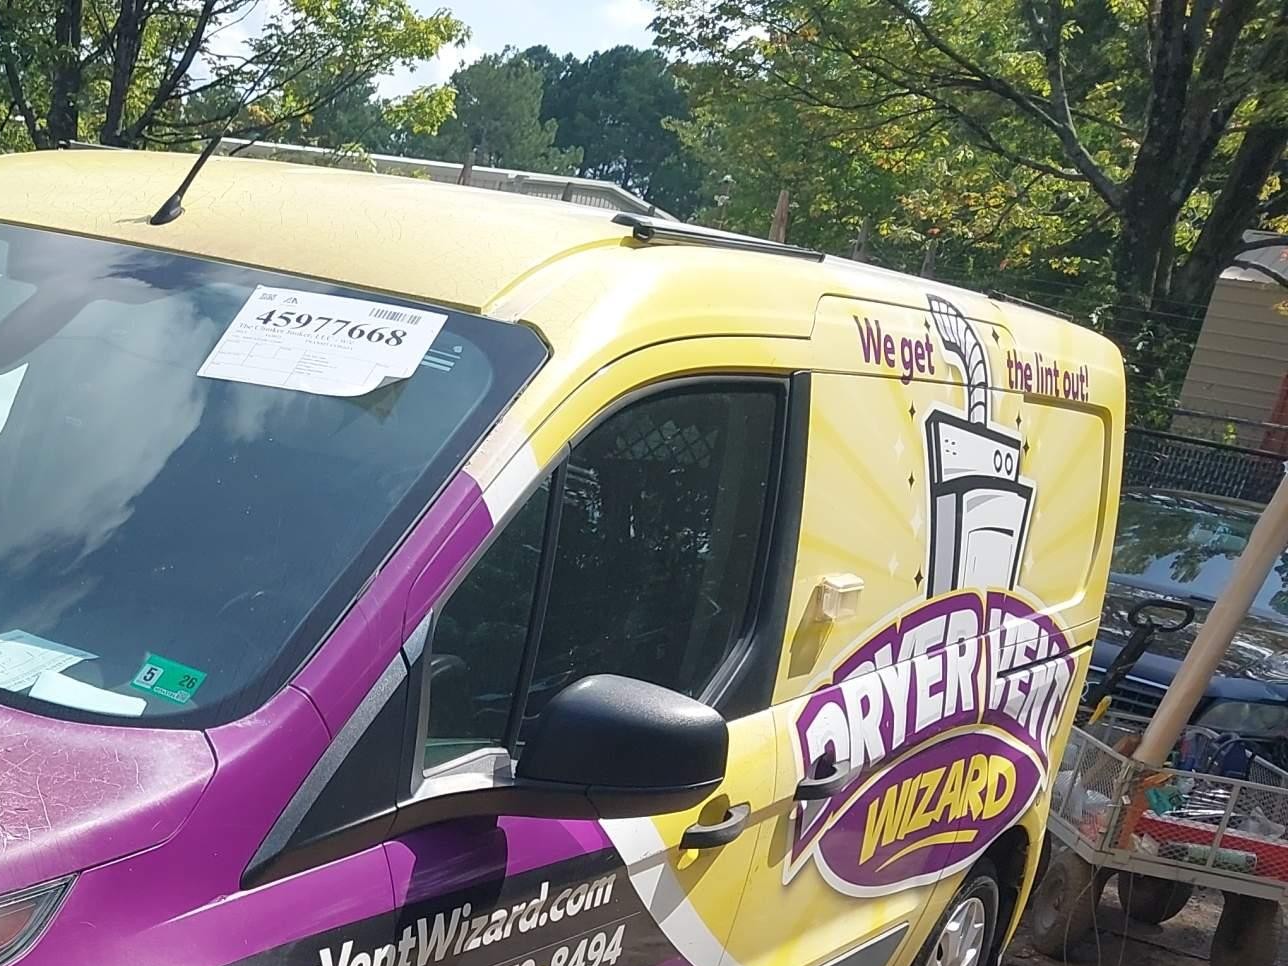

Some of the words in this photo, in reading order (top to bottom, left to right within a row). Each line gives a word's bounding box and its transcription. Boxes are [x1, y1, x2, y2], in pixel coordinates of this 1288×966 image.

[256, 309, 408, 347] 45977668
[853, 315, 895, 368] We
[900, 333, 935, 385] get
[1006, 349, 1033, 393] the
[1035, 352, 1060, 397] lint
[1063, 364, 1089, 403] out!
[143, 667, 158, 681] 5
[178, 675, 198, 689] 26
[800, 608, 980, 838] DRYER
[988, 608, 1071, 755] VENT
[859, 754, 1017, 865] WIZARD
